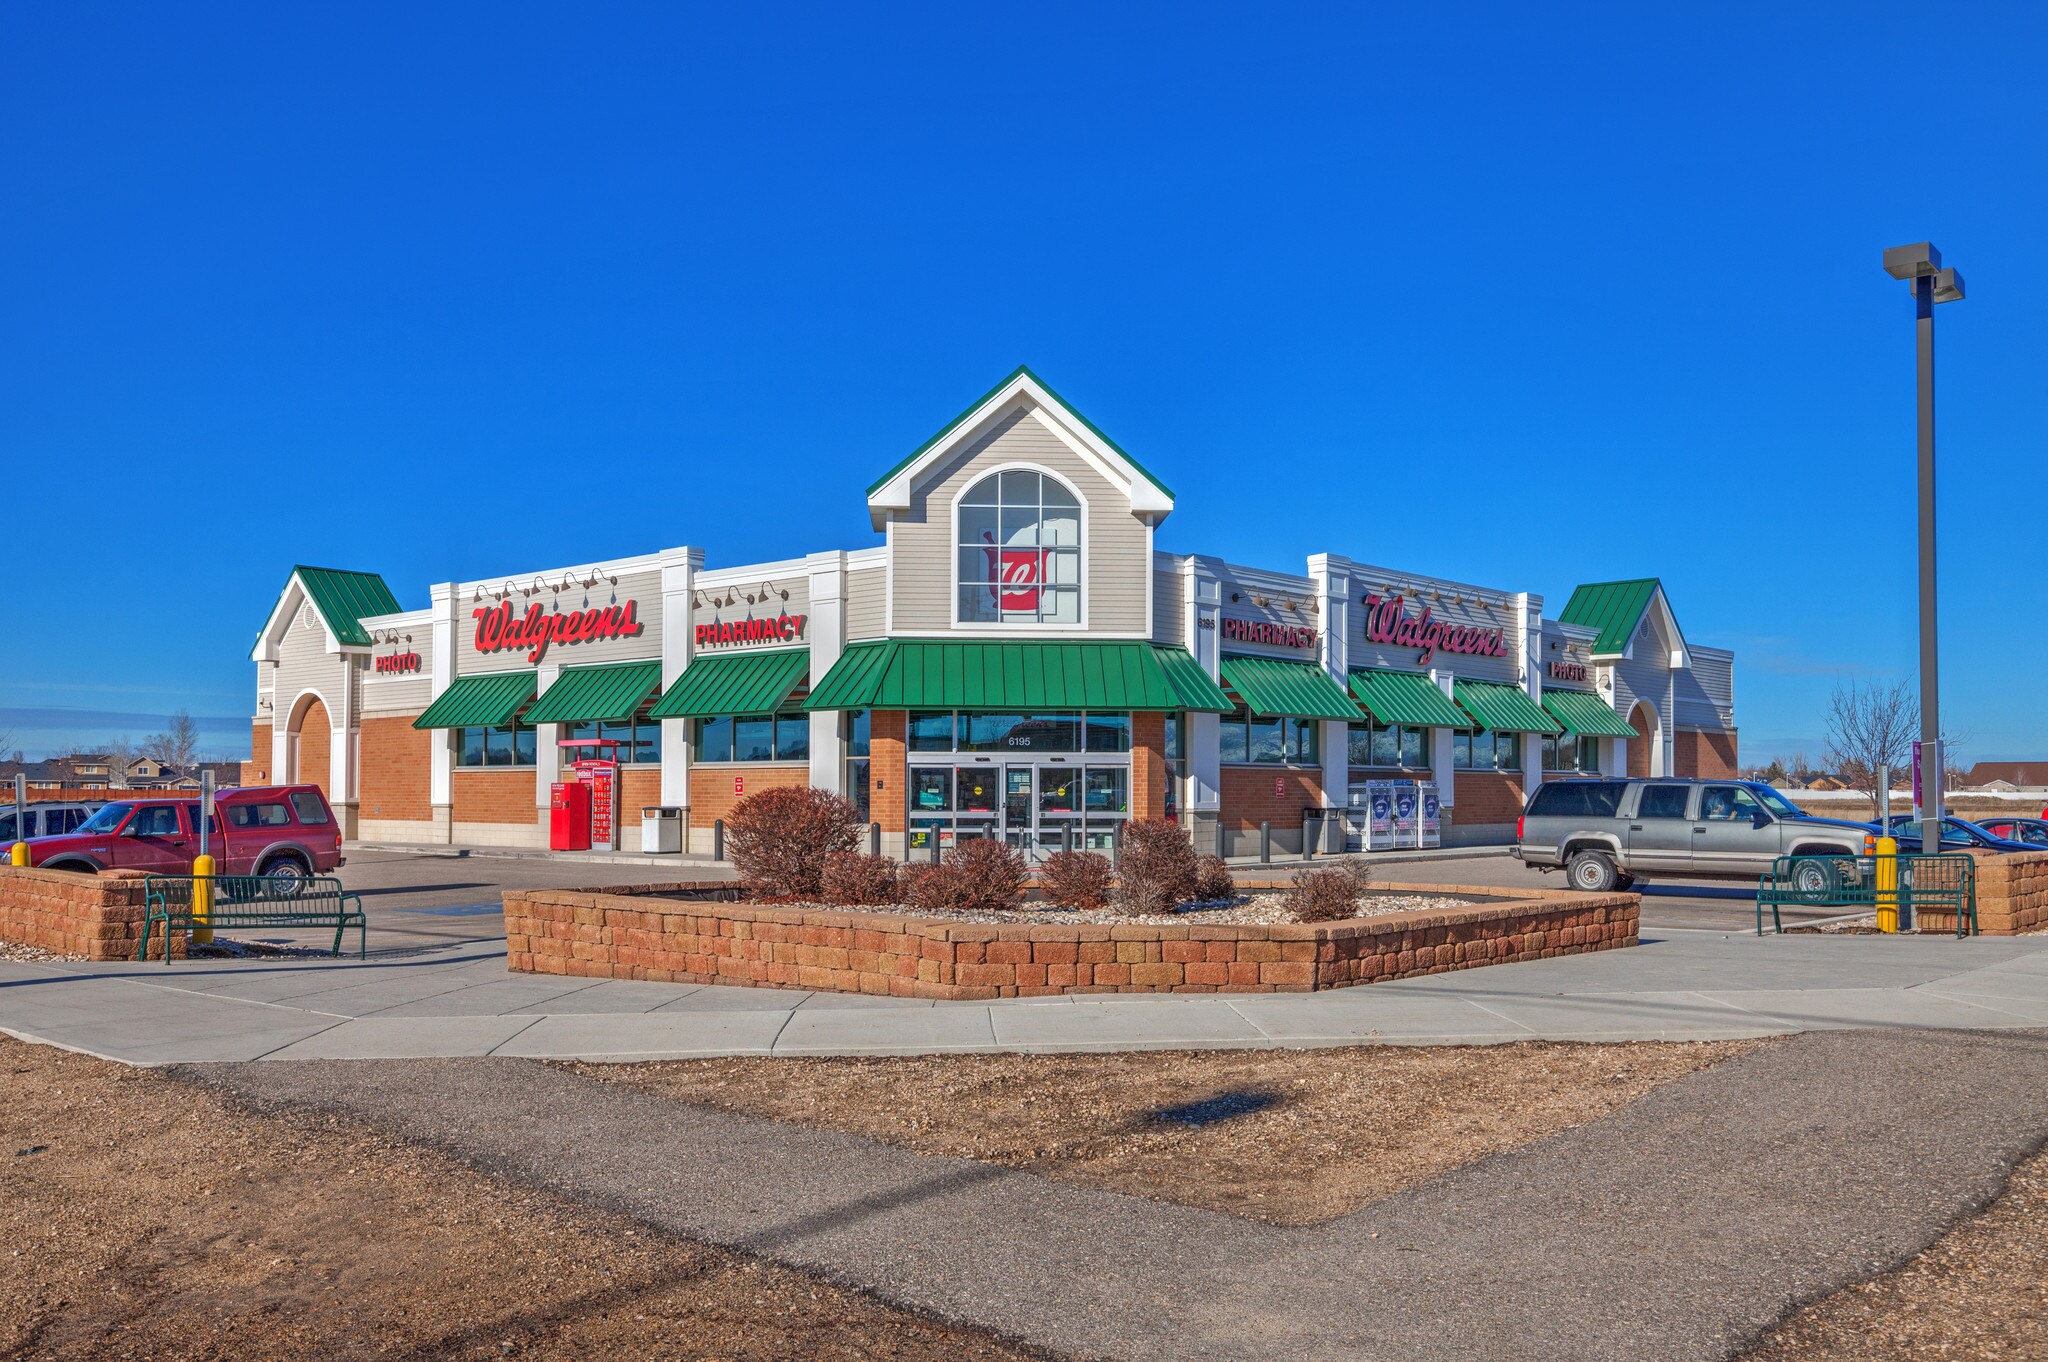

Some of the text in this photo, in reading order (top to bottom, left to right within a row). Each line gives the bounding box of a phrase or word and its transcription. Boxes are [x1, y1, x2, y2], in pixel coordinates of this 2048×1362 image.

[472, 599, 640, 664] Walgreens
[695, 614, 803, 645] PHARMACY
[1197, 617, 1216, 629] 6195
[1223, 617, 1318, 649] PHARMACY
[1364, 594, 1509, 666] Walgreens
[375, 652, 417, 673] PHOTO
[1551, 661, 1587, 681] PHOTO
[1008, 737, 1031, 746] 6195
